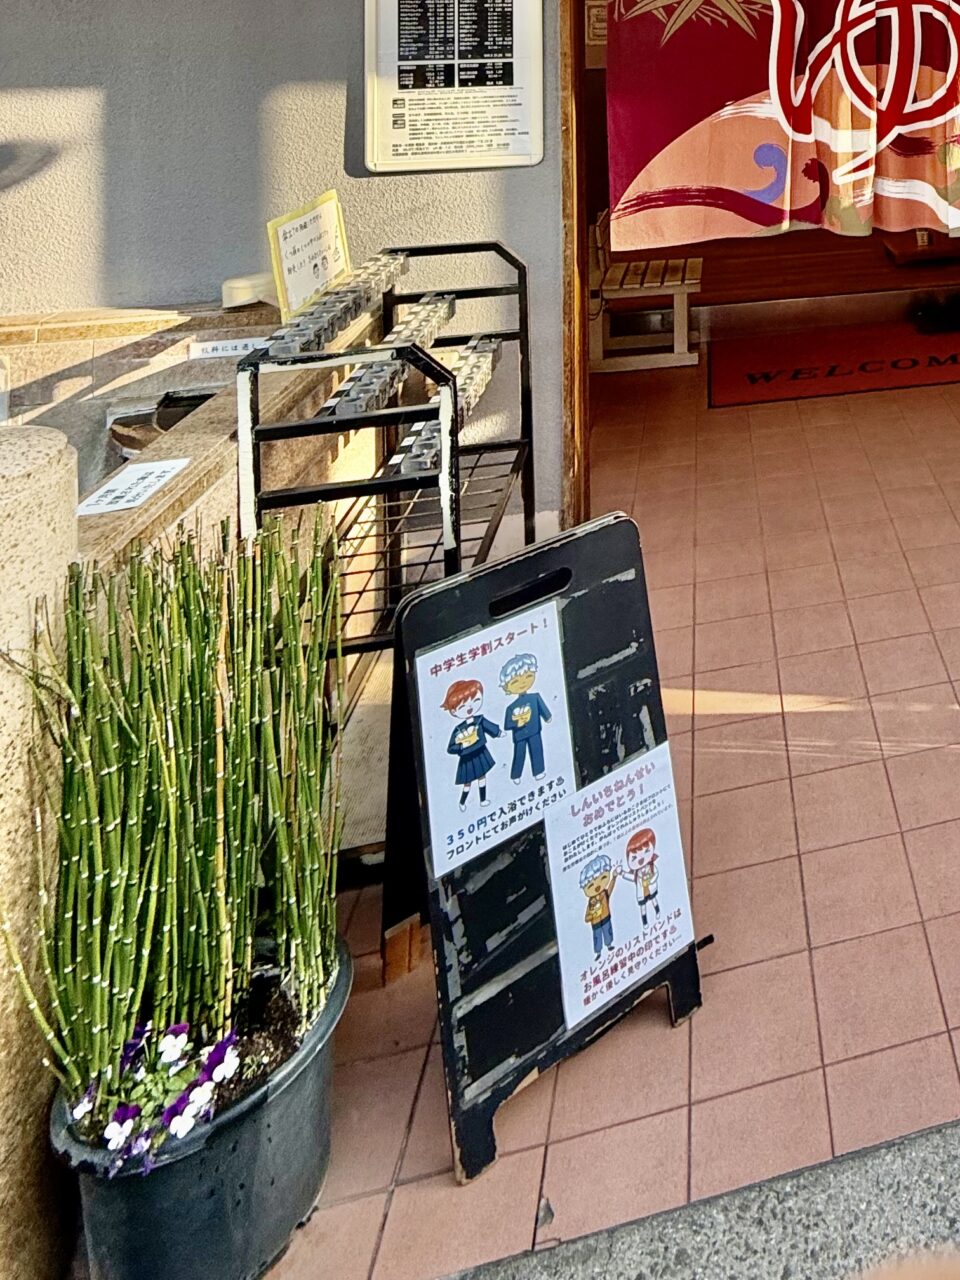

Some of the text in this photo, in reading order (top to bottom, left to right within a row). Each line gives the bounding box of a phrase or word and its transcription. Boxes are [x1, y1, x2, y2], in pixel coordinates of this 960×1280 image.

[430, 618, 548, 678] 中学生学割スタート！
[570, 762, 656, 817] しんいちねんせい
[583, 783, 644, 827] おめでとう！
[446, 788, 567, 860] フロントにてお声がけください
[580, 907, 682, 982] オレンジのリストバンドは
